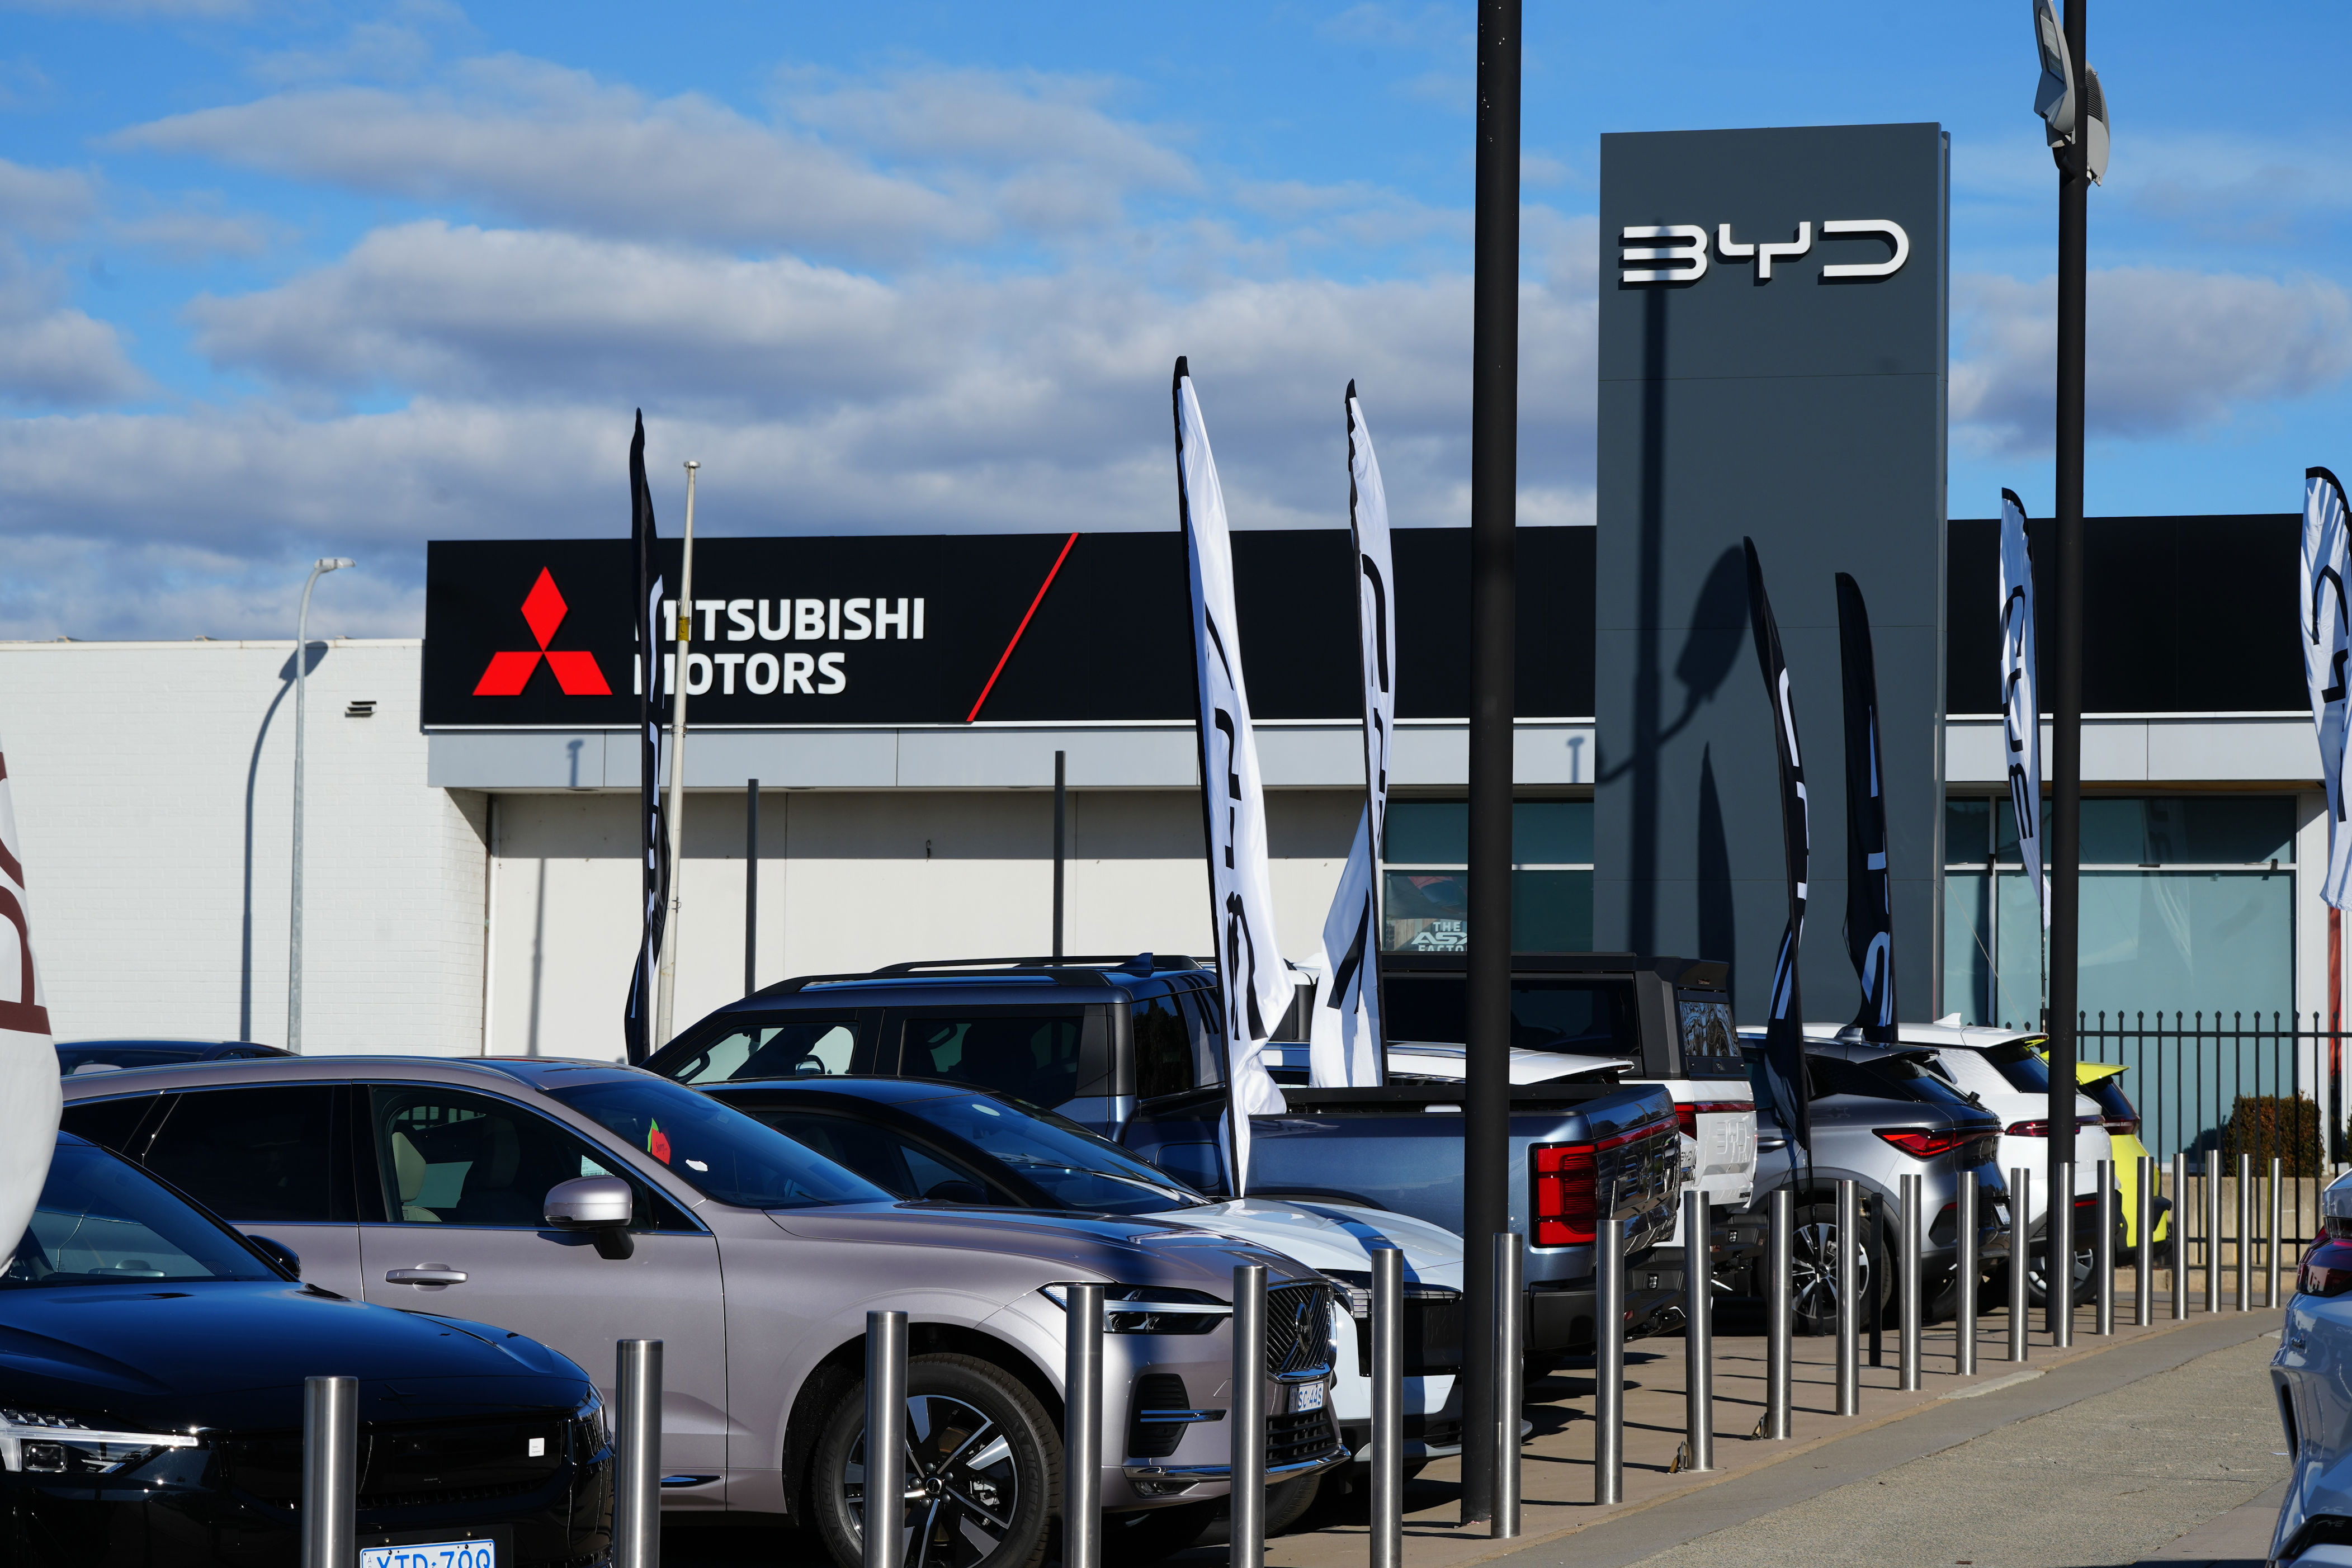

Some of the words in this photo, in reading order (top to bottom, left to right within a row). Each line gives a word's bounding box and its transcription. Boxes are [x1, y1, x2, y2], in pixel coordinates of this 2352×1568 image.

[1624, 219, 1909, 282] BYD
[635, 597, 924, 641] TSUBISHI
[1433, 922, 1461, 932] THE
